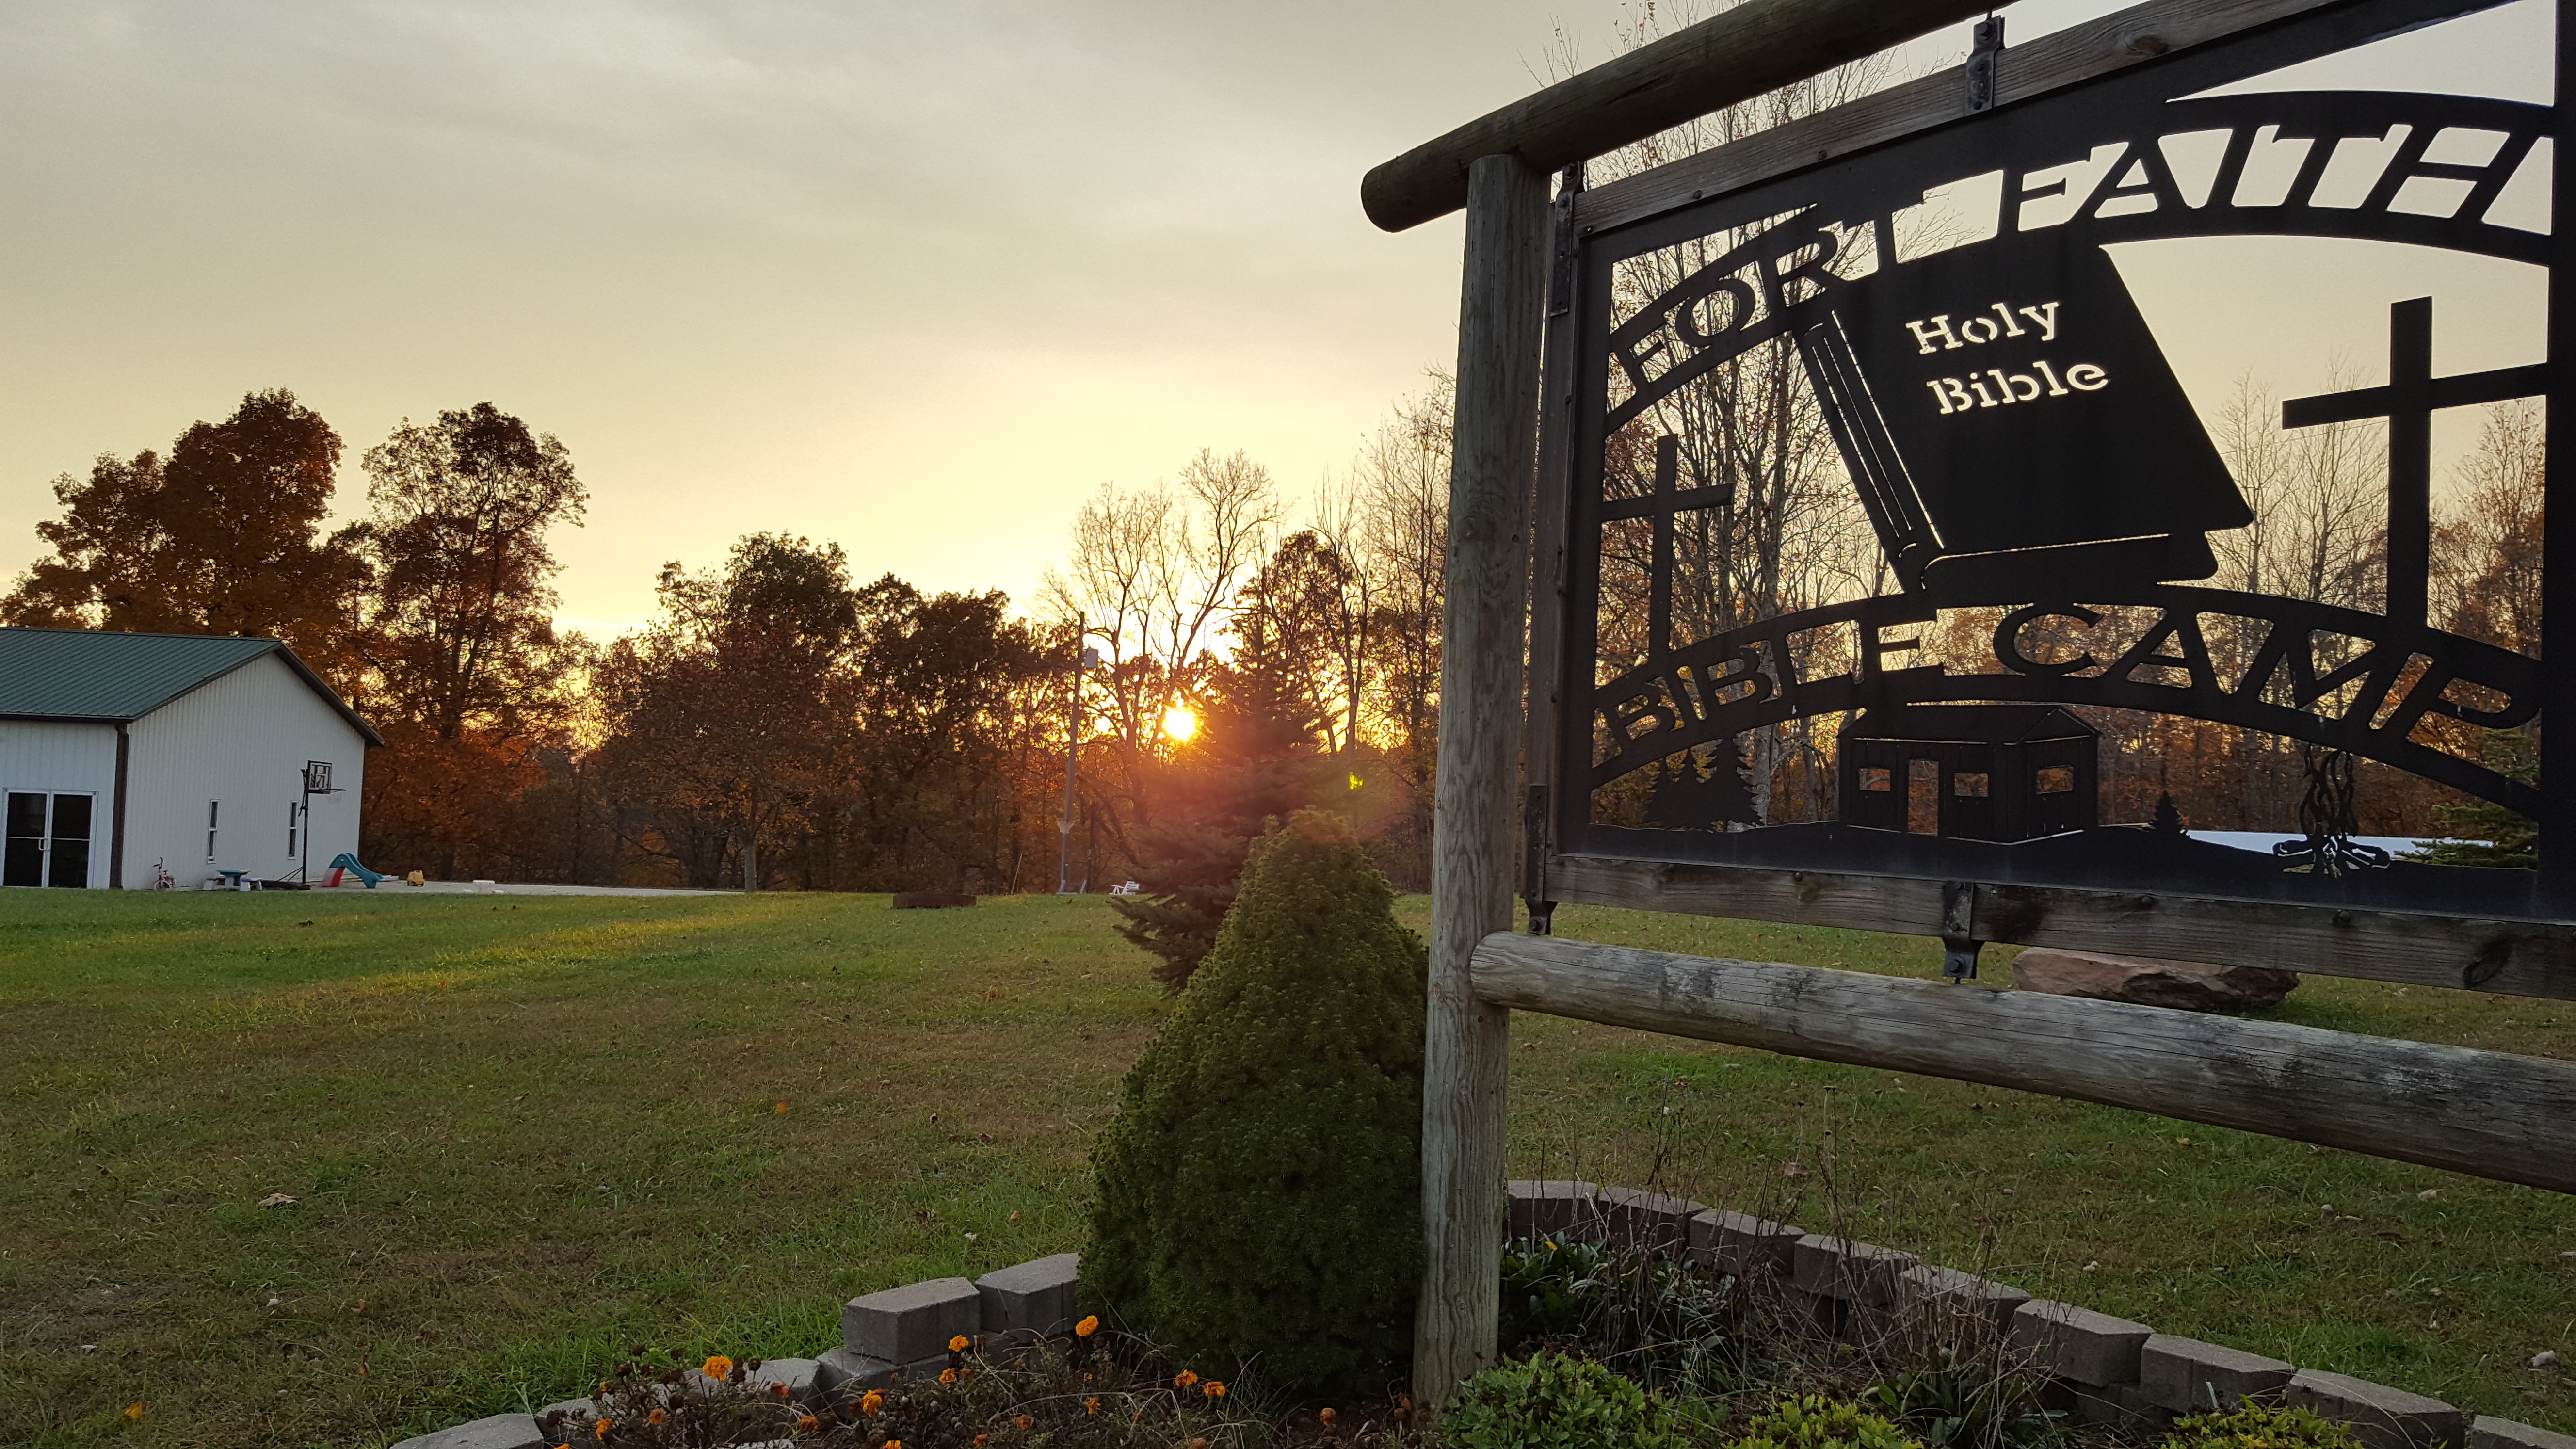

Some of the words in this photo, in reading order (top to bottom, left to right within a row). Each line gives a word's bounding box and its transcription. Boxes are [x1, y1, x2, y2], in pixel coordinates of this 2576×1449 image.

[1610, 191, 1924, 395] FORT
[1996, 124, 2542, 238] FAITH
[1905, 301, 2060, 354] Holy
[1926, 360, 2109, 415] Bible
[1599, 609, 1944, 752] BIBLE
[1993, 603, 2540, 741] CAMP
